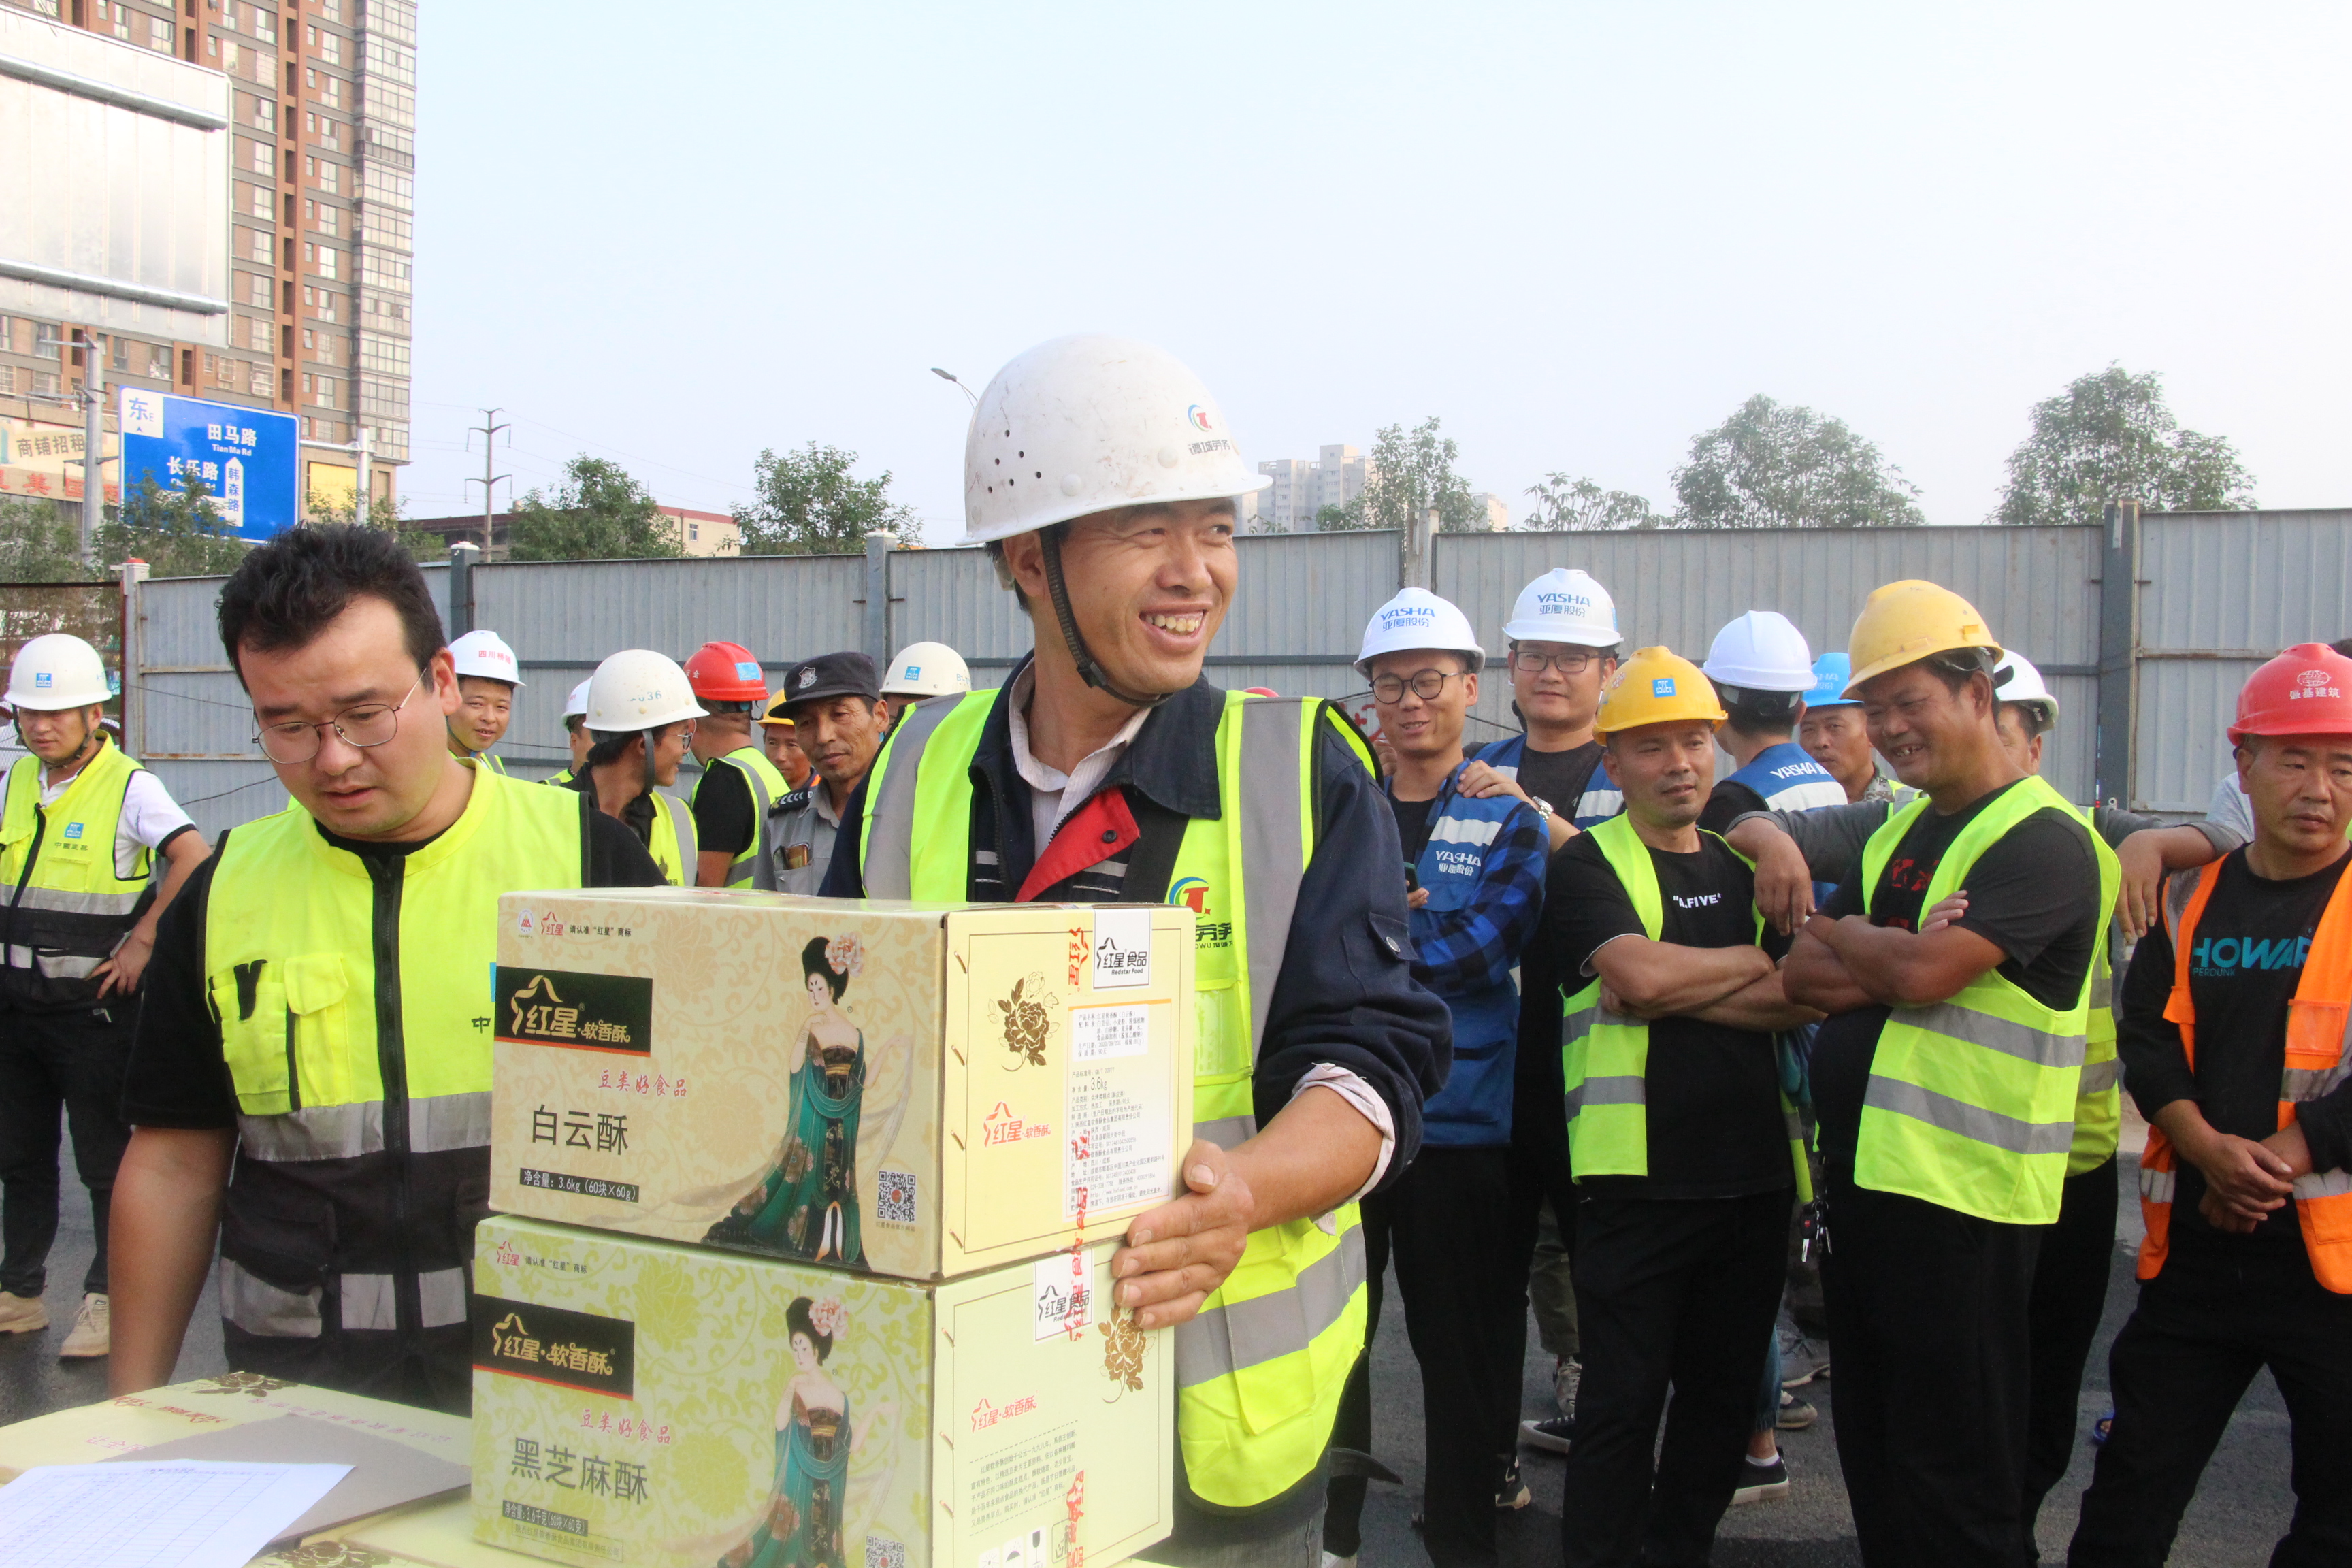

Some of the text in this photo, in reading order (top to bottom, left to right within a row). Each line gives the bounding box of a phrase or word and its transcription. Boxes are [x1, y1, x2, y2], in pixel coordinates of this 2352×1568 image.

[129, 397, 148, 421] 东
[149, 412, 154, 422] E
[16, 434, 85, 458] 商铺招租
[208, 424, 257, 447] 田马路
[212, 444, 252, 457] Tian Ma Rd
[167, 456, 219, 481] 长乐路
[229, 468, 240, 512] 韩森路
[1537, 593, 1590, 607] YASHA
[1381, 607, 1435, 621] YASHA
[1539, 604, 1586, 618] 亚厦股份
[1382, 617, 1430, 632] 亚厦股份
[1769, 762, 1818, 779] YASHA
[1435, 850, 1482, 867] YASHA
[1103, 951, 1147, 968] 红星 食品
[471, 1015, 491, 1034] 中
[598, 1069, 687, 1097] 豆类好食品
[532, 1104, 629, 1156] 白云酥
[1045, 1290, 1090, 1318] 红星 食品
[581, 1409, 671, 1444] 豆类好食品
[511, 1437, 648, 1505] 黑芝麻酥
